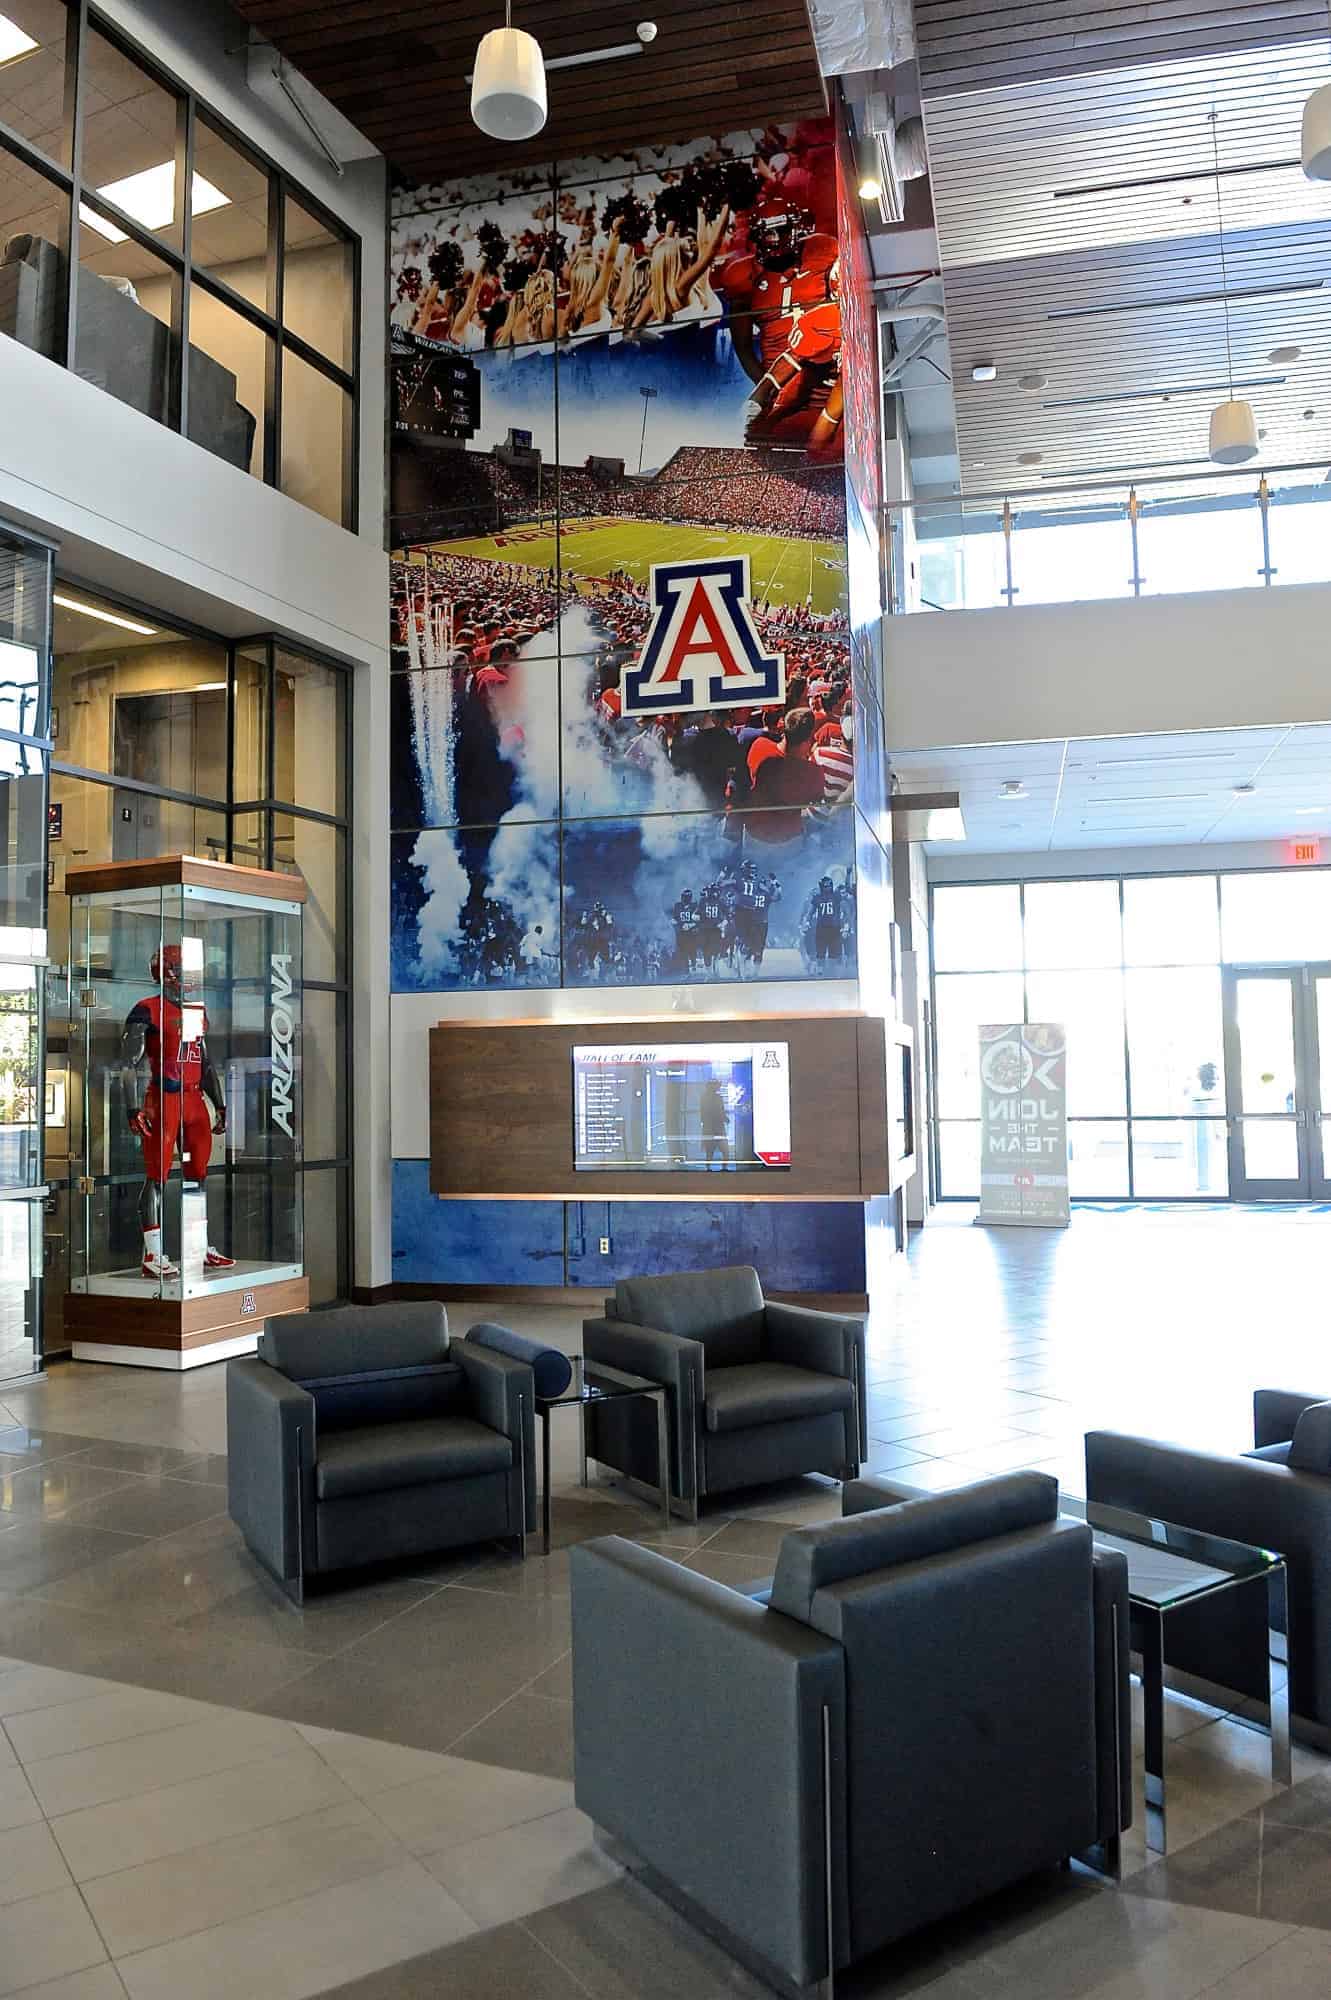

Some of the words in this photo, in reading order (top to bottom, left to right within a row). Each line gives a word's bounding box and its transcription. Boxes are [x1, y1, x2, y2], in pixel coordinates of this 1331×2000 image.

[621, 554, 786, 717] A
[1296, 844, 1314, 860] EXIT
[743, 881, 754, 896] 11
[754, 895, 766, 908] 12
[820, 902, 833, 915] 76
[271, 954, 294, 1140] ARIZONA
